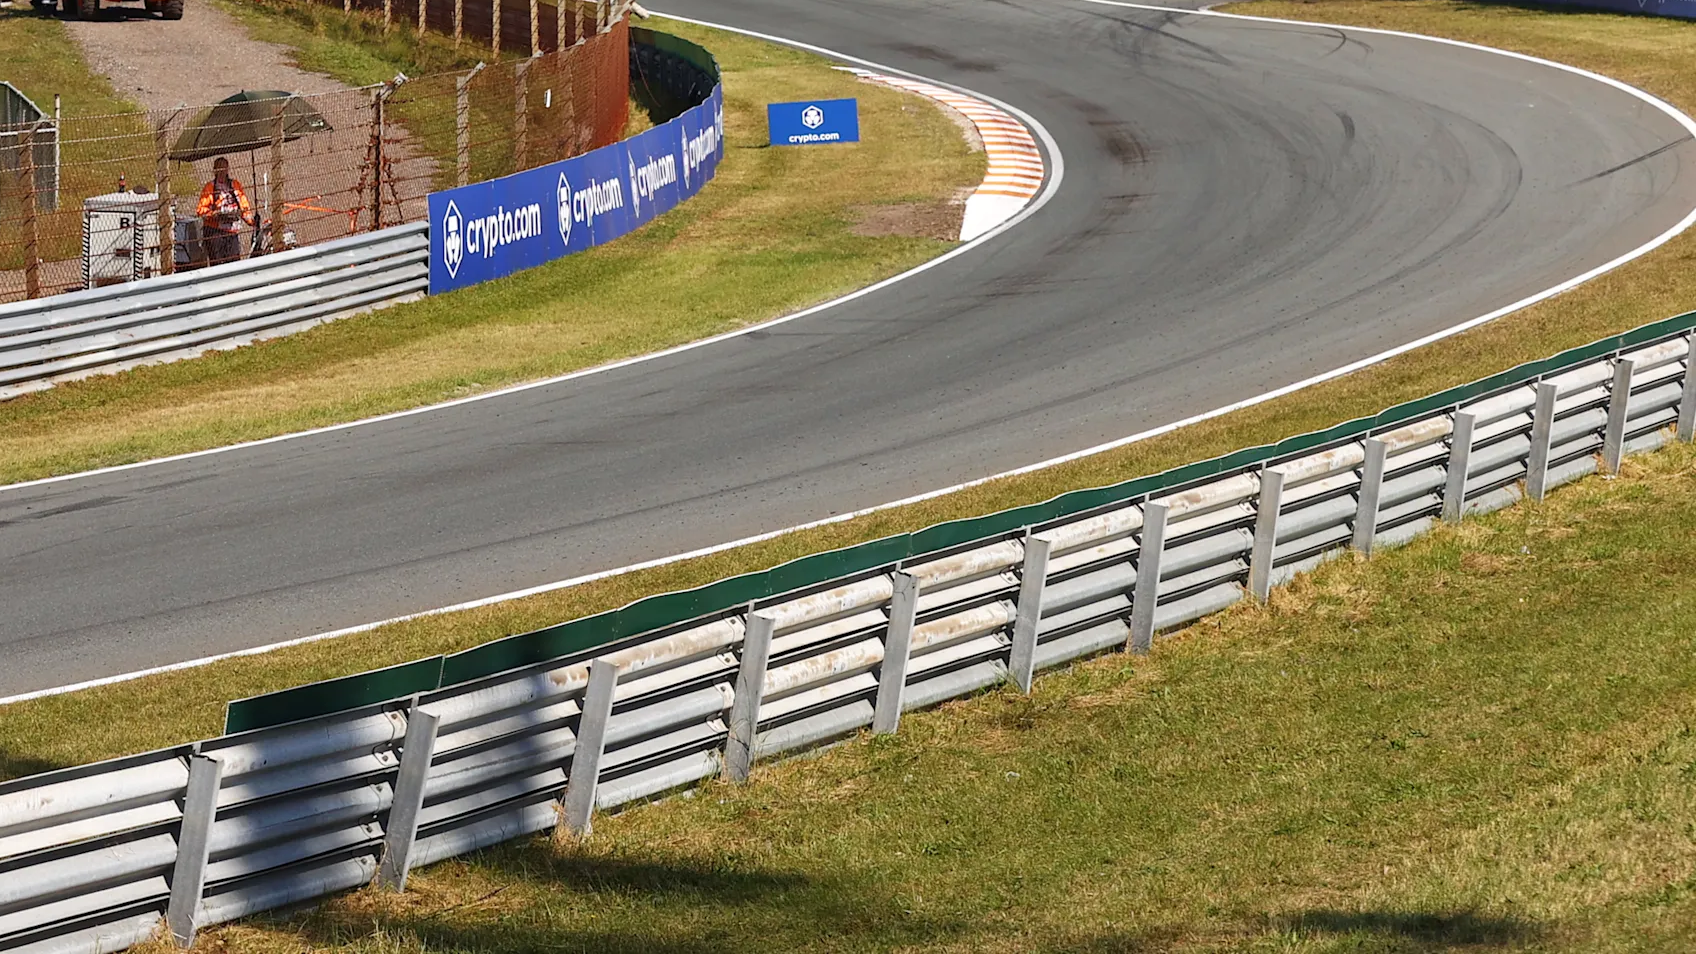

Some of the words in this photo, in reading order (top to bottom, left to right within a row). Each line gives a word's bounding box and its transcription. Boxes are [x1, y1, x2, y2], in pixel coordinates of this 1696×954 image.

[788, 132, 840, 144] crypto.com
[573, 177, 624, 228] crypto.com
[466, 202, 542, 259] crypto.com
